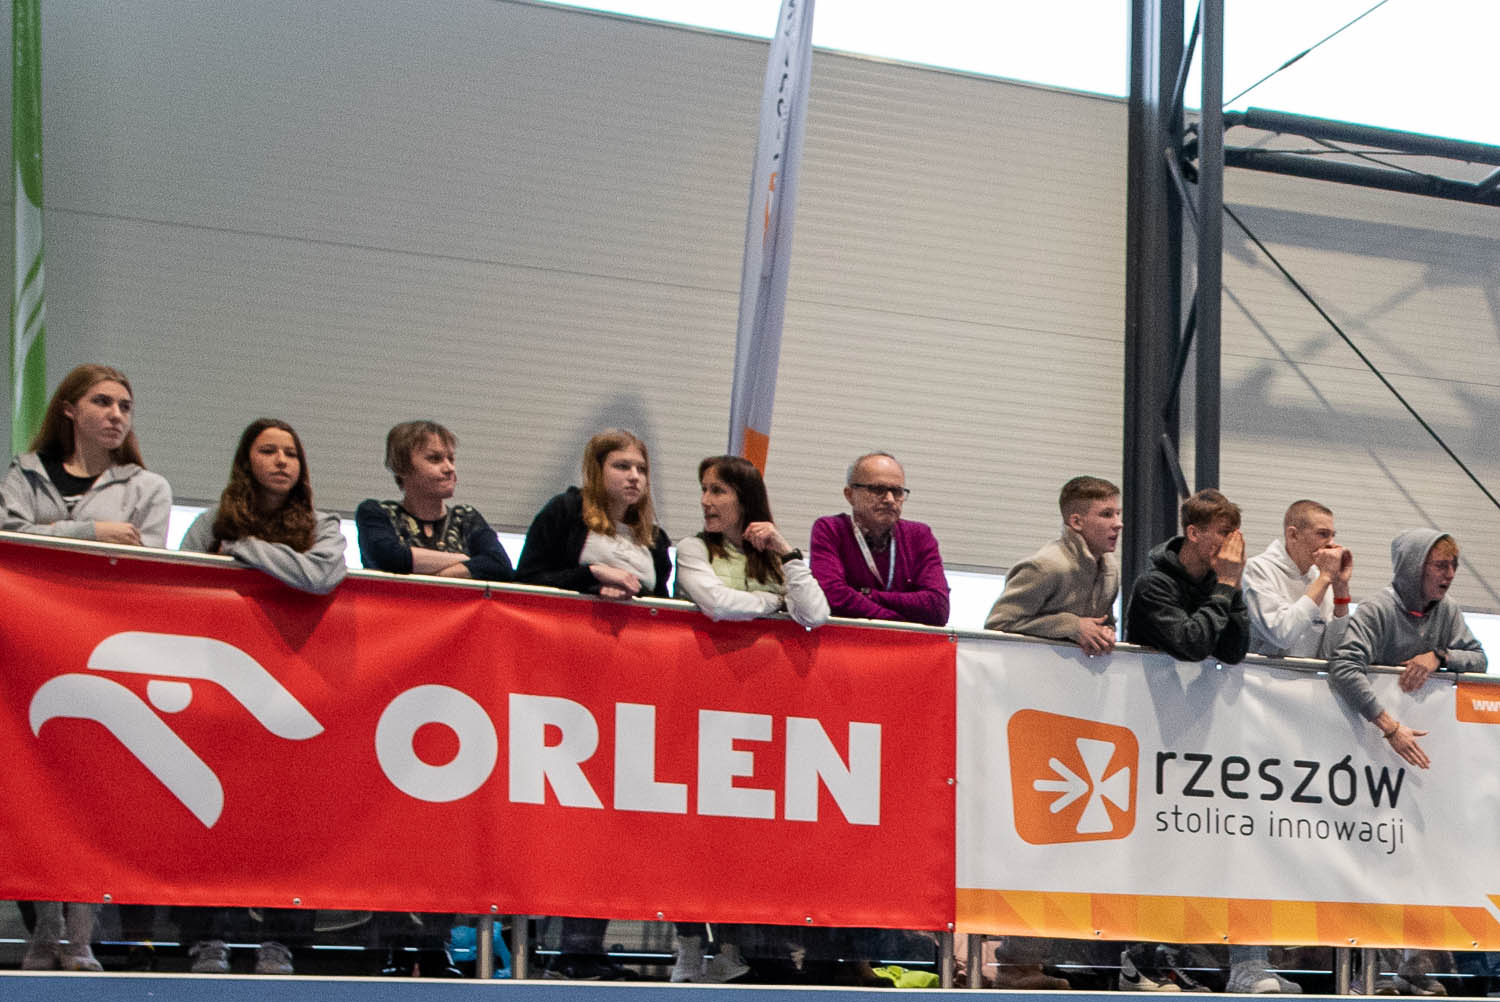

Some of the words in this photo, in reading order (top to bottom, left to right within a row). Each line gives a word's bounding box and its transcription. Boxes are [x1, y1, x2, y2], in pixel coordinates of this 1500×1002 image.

[375, 683, 882, 826] ORLEN
[1155, 751, 1406, 809] rzeszów
[1156, 804, 1255, 836] stolica
[1269, 811, 1405, 854] innowacji
